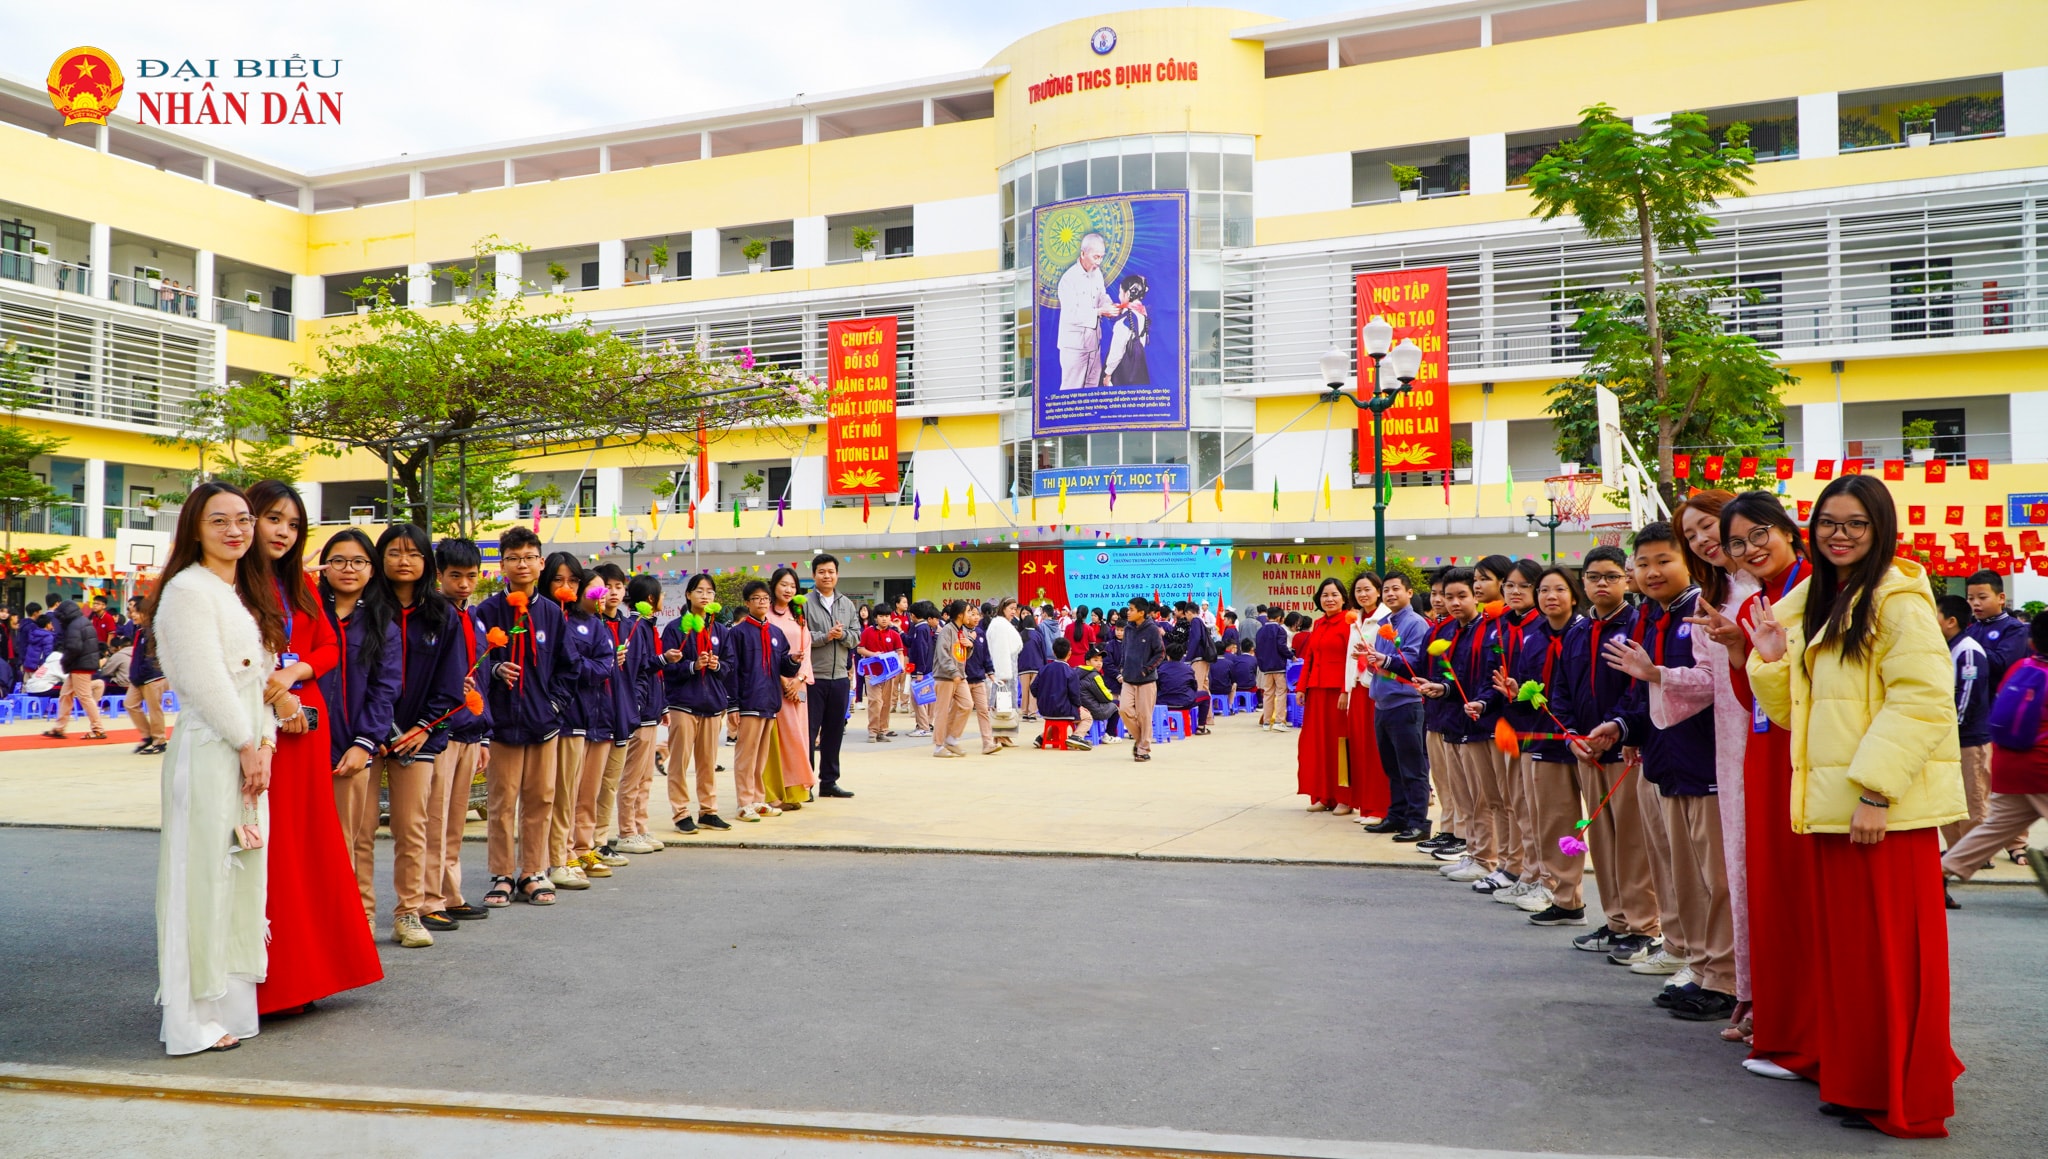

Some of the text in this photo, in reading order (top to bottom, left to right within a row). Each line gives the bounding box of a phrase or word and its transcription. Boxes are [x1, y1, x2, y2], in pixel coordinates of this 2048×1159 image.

[1028, 57, 1198, 104] TRƯỜNG THCS ĐỊNH CÔNG
[1373, 282, 1430, 306] HỌC TẬP
[1408, 309, 1435, 330] TẠO
[842, 326, 883, 347] CHUYỂN
[844, 349, 879, 370] ĐỔI SỐ
[836, 376, 888, 392] NÂNG CAO
[831, 397, 893, 417] CHẤT LƯỢNG
[1408, 390, 1434, 410] TẠO
[842, 418, 881, 439] KẾT NỐI
[1417, 416, 1438, 434] LAI
[836, 446, 888, 462] TƯƠNG LAI
[1042, 478, 1055, 488] THI
[1080, 474, 1100, 490] DẠY
[1104, 470, 1126, 486] TỐT,
[1130, 474, 1152, 488] HỌC
[1155, 468, 1176, 484] TỐT
[1263, 568, 1321, 579] HOÀN THÀNH
[942, 579, 981, 590] KỶ CƯƠNG
[1268, 582, 1315, 597] THẮNG LỢI
[1303, 602, 1314, 613] VỤ
